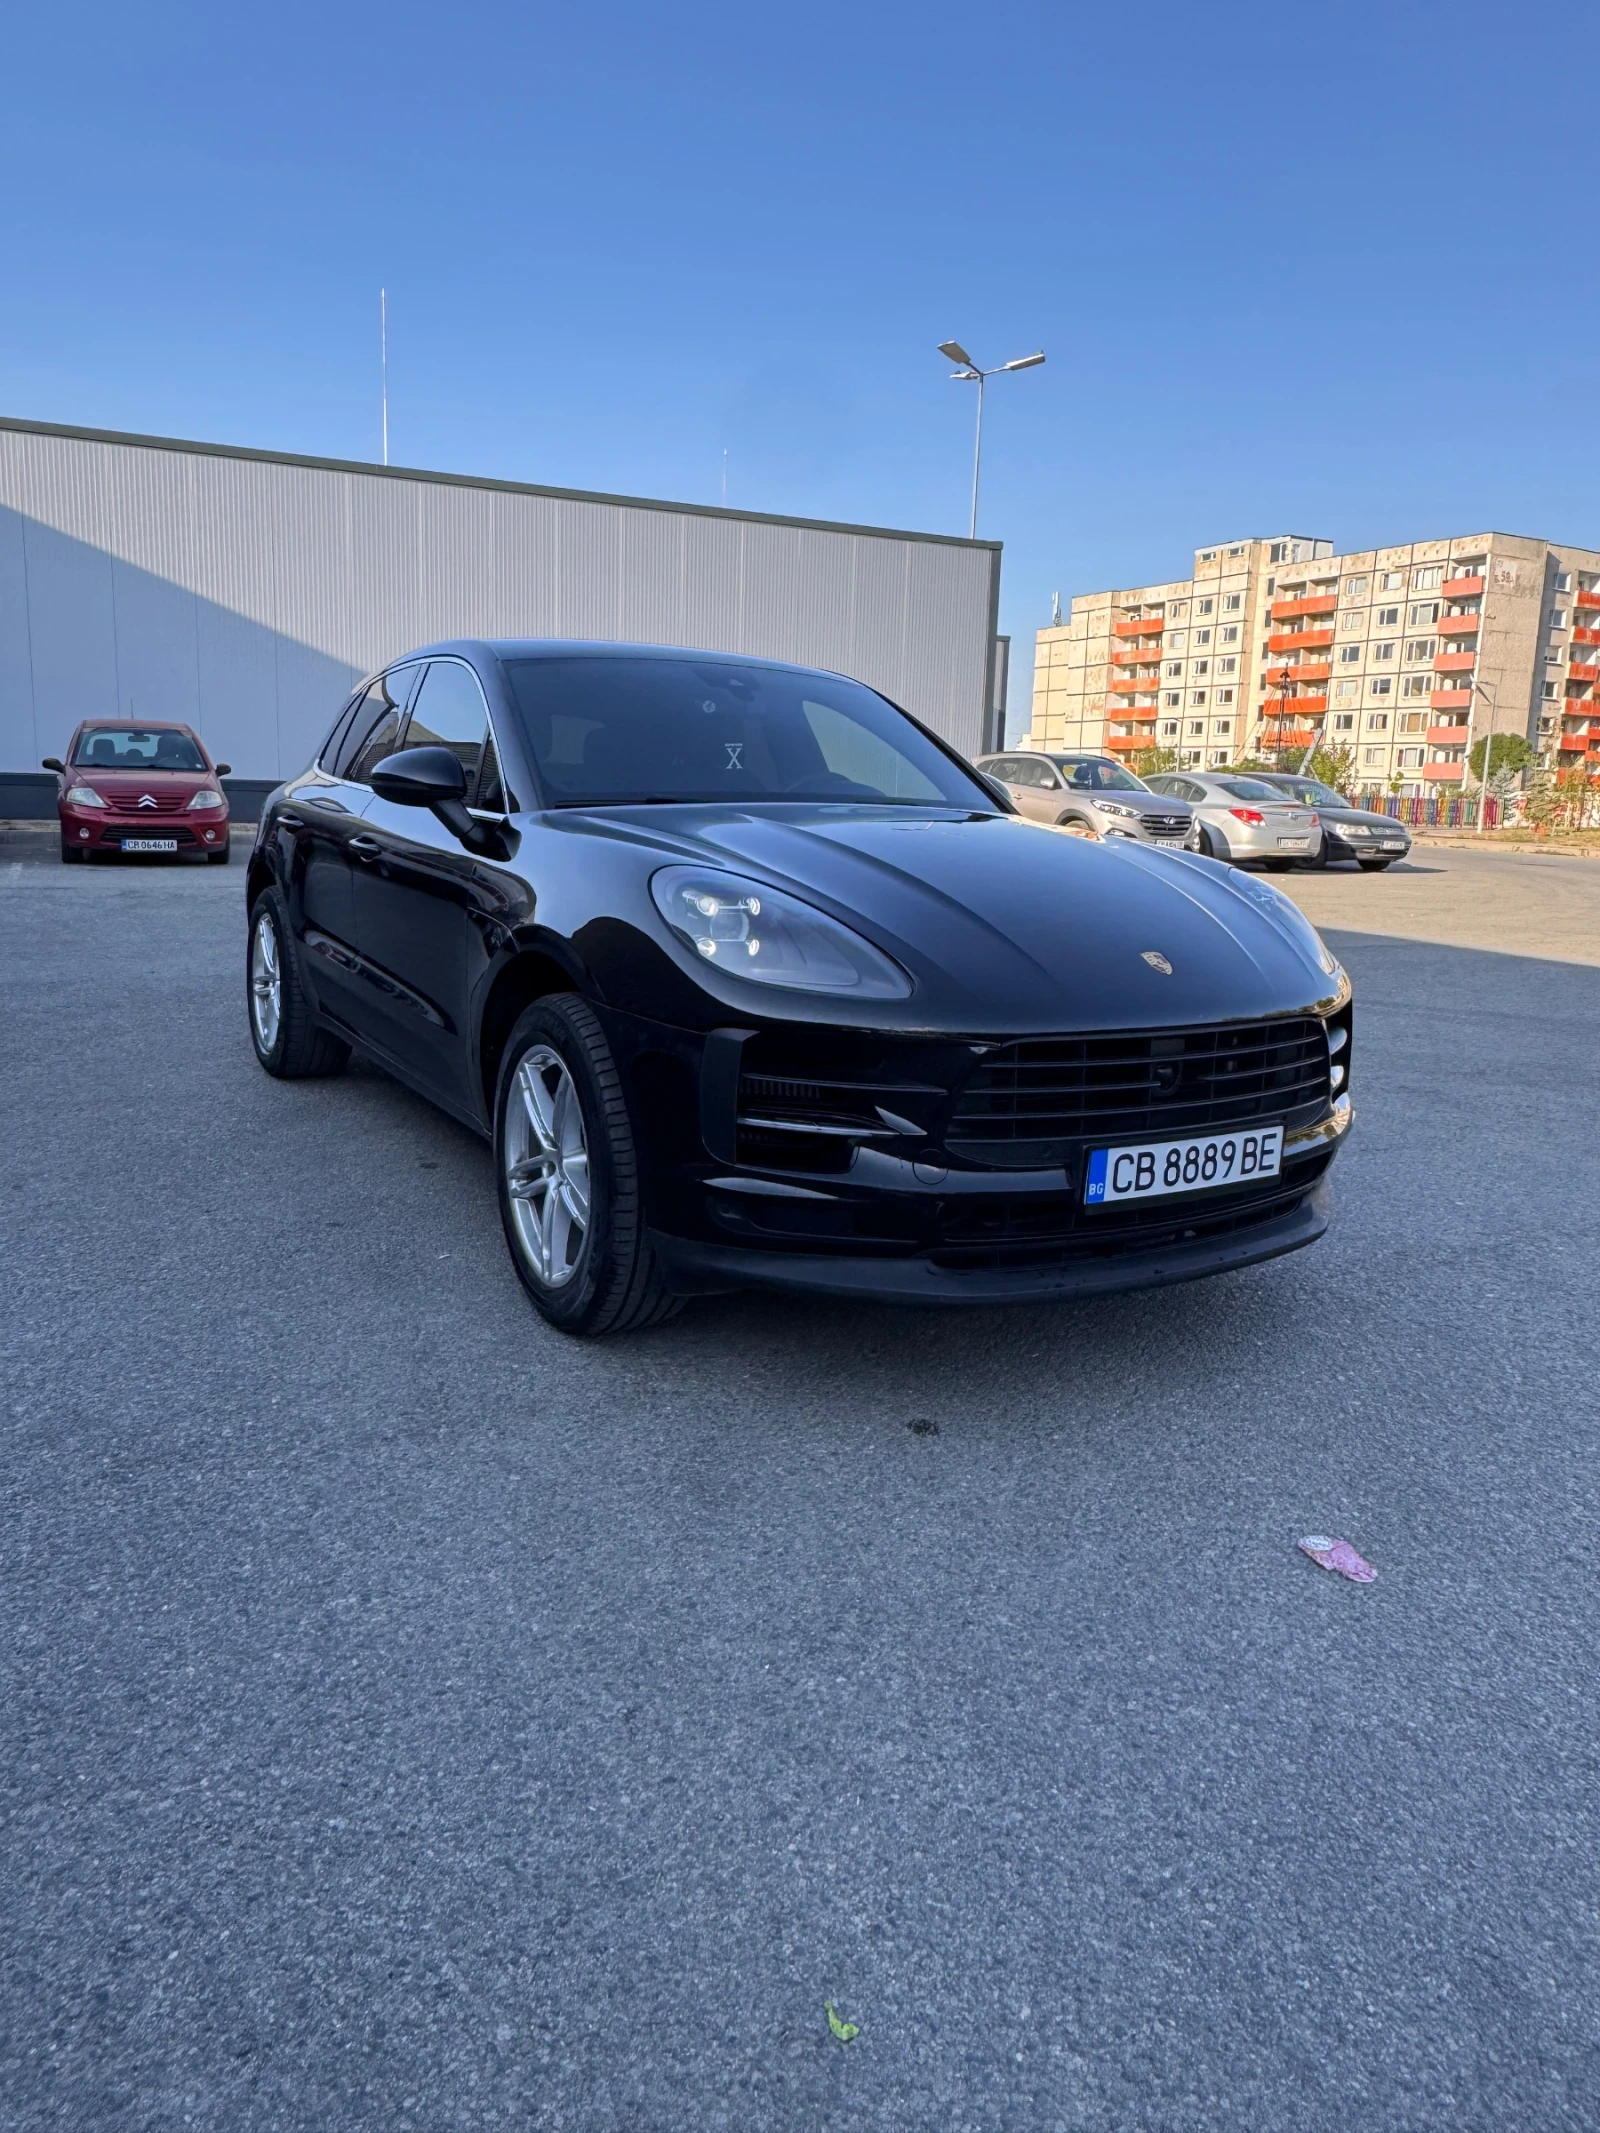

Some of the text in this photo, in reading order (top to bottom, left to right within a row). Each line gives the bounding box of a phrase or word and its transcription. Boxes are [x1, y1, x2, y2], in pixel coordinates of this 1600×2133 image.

[141, 841, 162, 850] 0646
[1112, 1132, 1277, 1194] CB 8889 BE
[1088, 1182, 1104, 1196] BG
